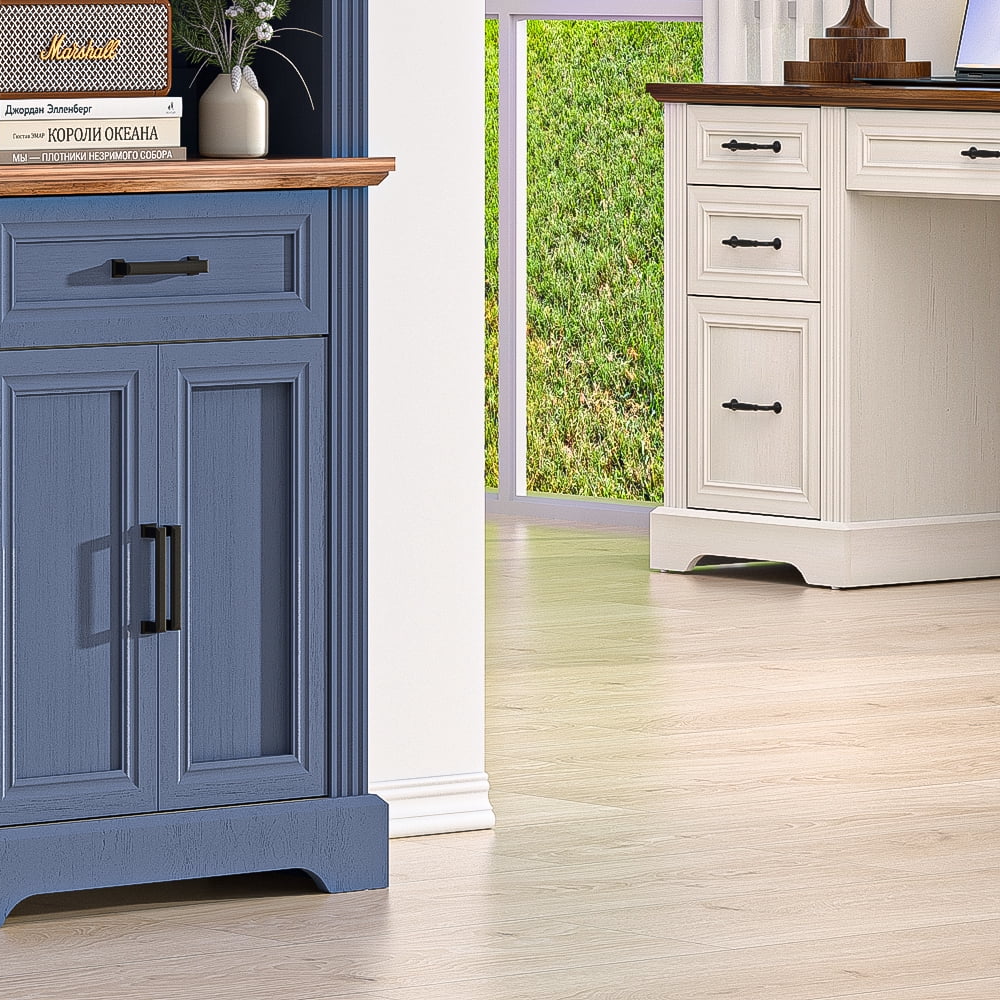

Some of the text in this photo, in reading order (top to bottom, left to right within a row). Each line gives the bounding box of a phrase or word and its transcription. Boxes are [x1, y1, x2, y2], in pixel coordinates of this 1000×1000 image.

[40, 33, 121, 60] Marshall
[4, 103, 92, 116] Джордан Элленберг
[47, 125, 159, 143] КОРОЛИ ОКЕАНА
[12, 149, 173, 163] МЫ ПЛОТНИКИ НЕЗРИМОГО СОБОРА
